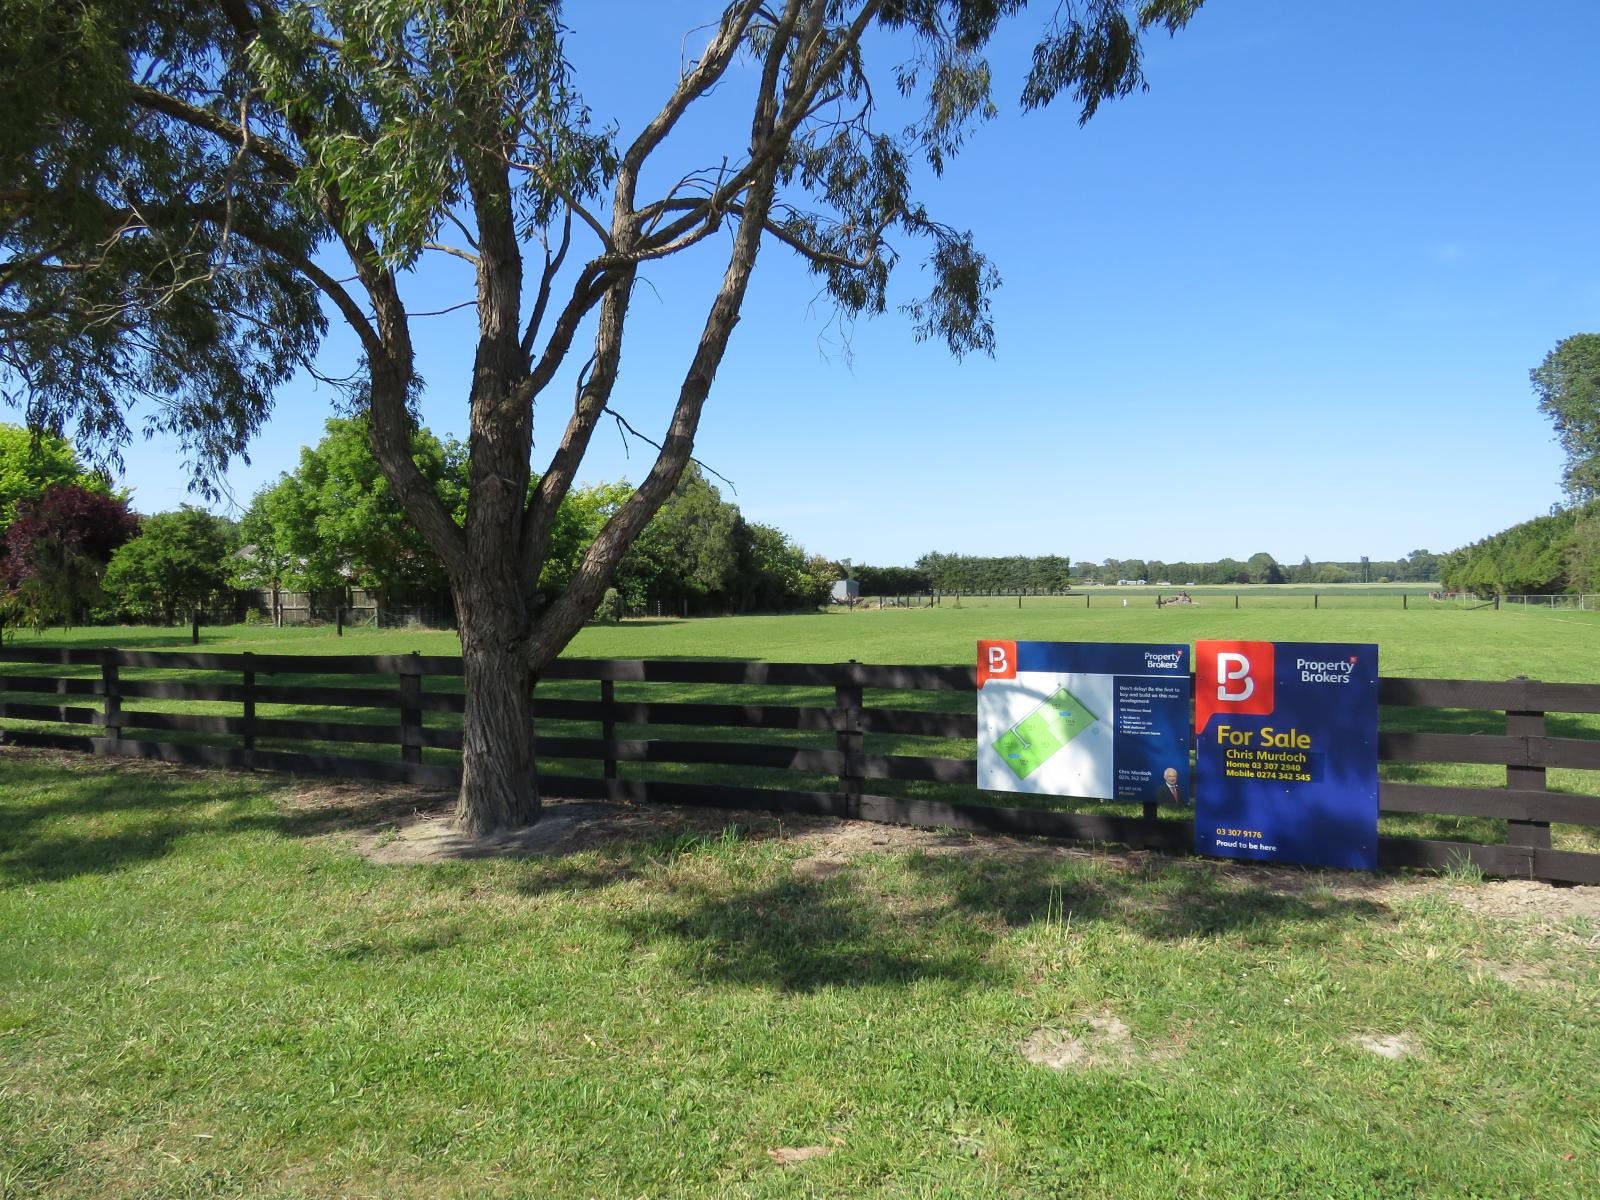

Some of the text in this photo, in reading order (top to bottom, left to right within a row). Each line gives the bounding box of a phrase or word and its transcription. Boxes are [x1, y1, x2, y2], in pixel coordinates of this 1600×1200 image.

[989, 646, 1008, 673] B
[1144, 652, 1181, 663] Property
[1147, 660, 1178, 669] Brokers
[1296, 658, 1354, 674] Property
[1217, 652, 1254, 702] B
[1301, 670, 1350, 684] Brokers
[1217, 725, 1312, 749] For Sale
[1226, 749, 1307, 763] Chris Murdoch
[1226, 761, 1250, 769] Home
[1263, 763, 1279, 771] 307
[1280, 764, 1301, 772] 2940
[1226, 769, 1312, 781] Mobile 0274 342 545
[1216, 828, 1262, 839] 03 307 9176
[1216, 839, 1238, 848] Proud
[1248, 842, 1259, 850] be
[1259, 843, 1277, 852] here
